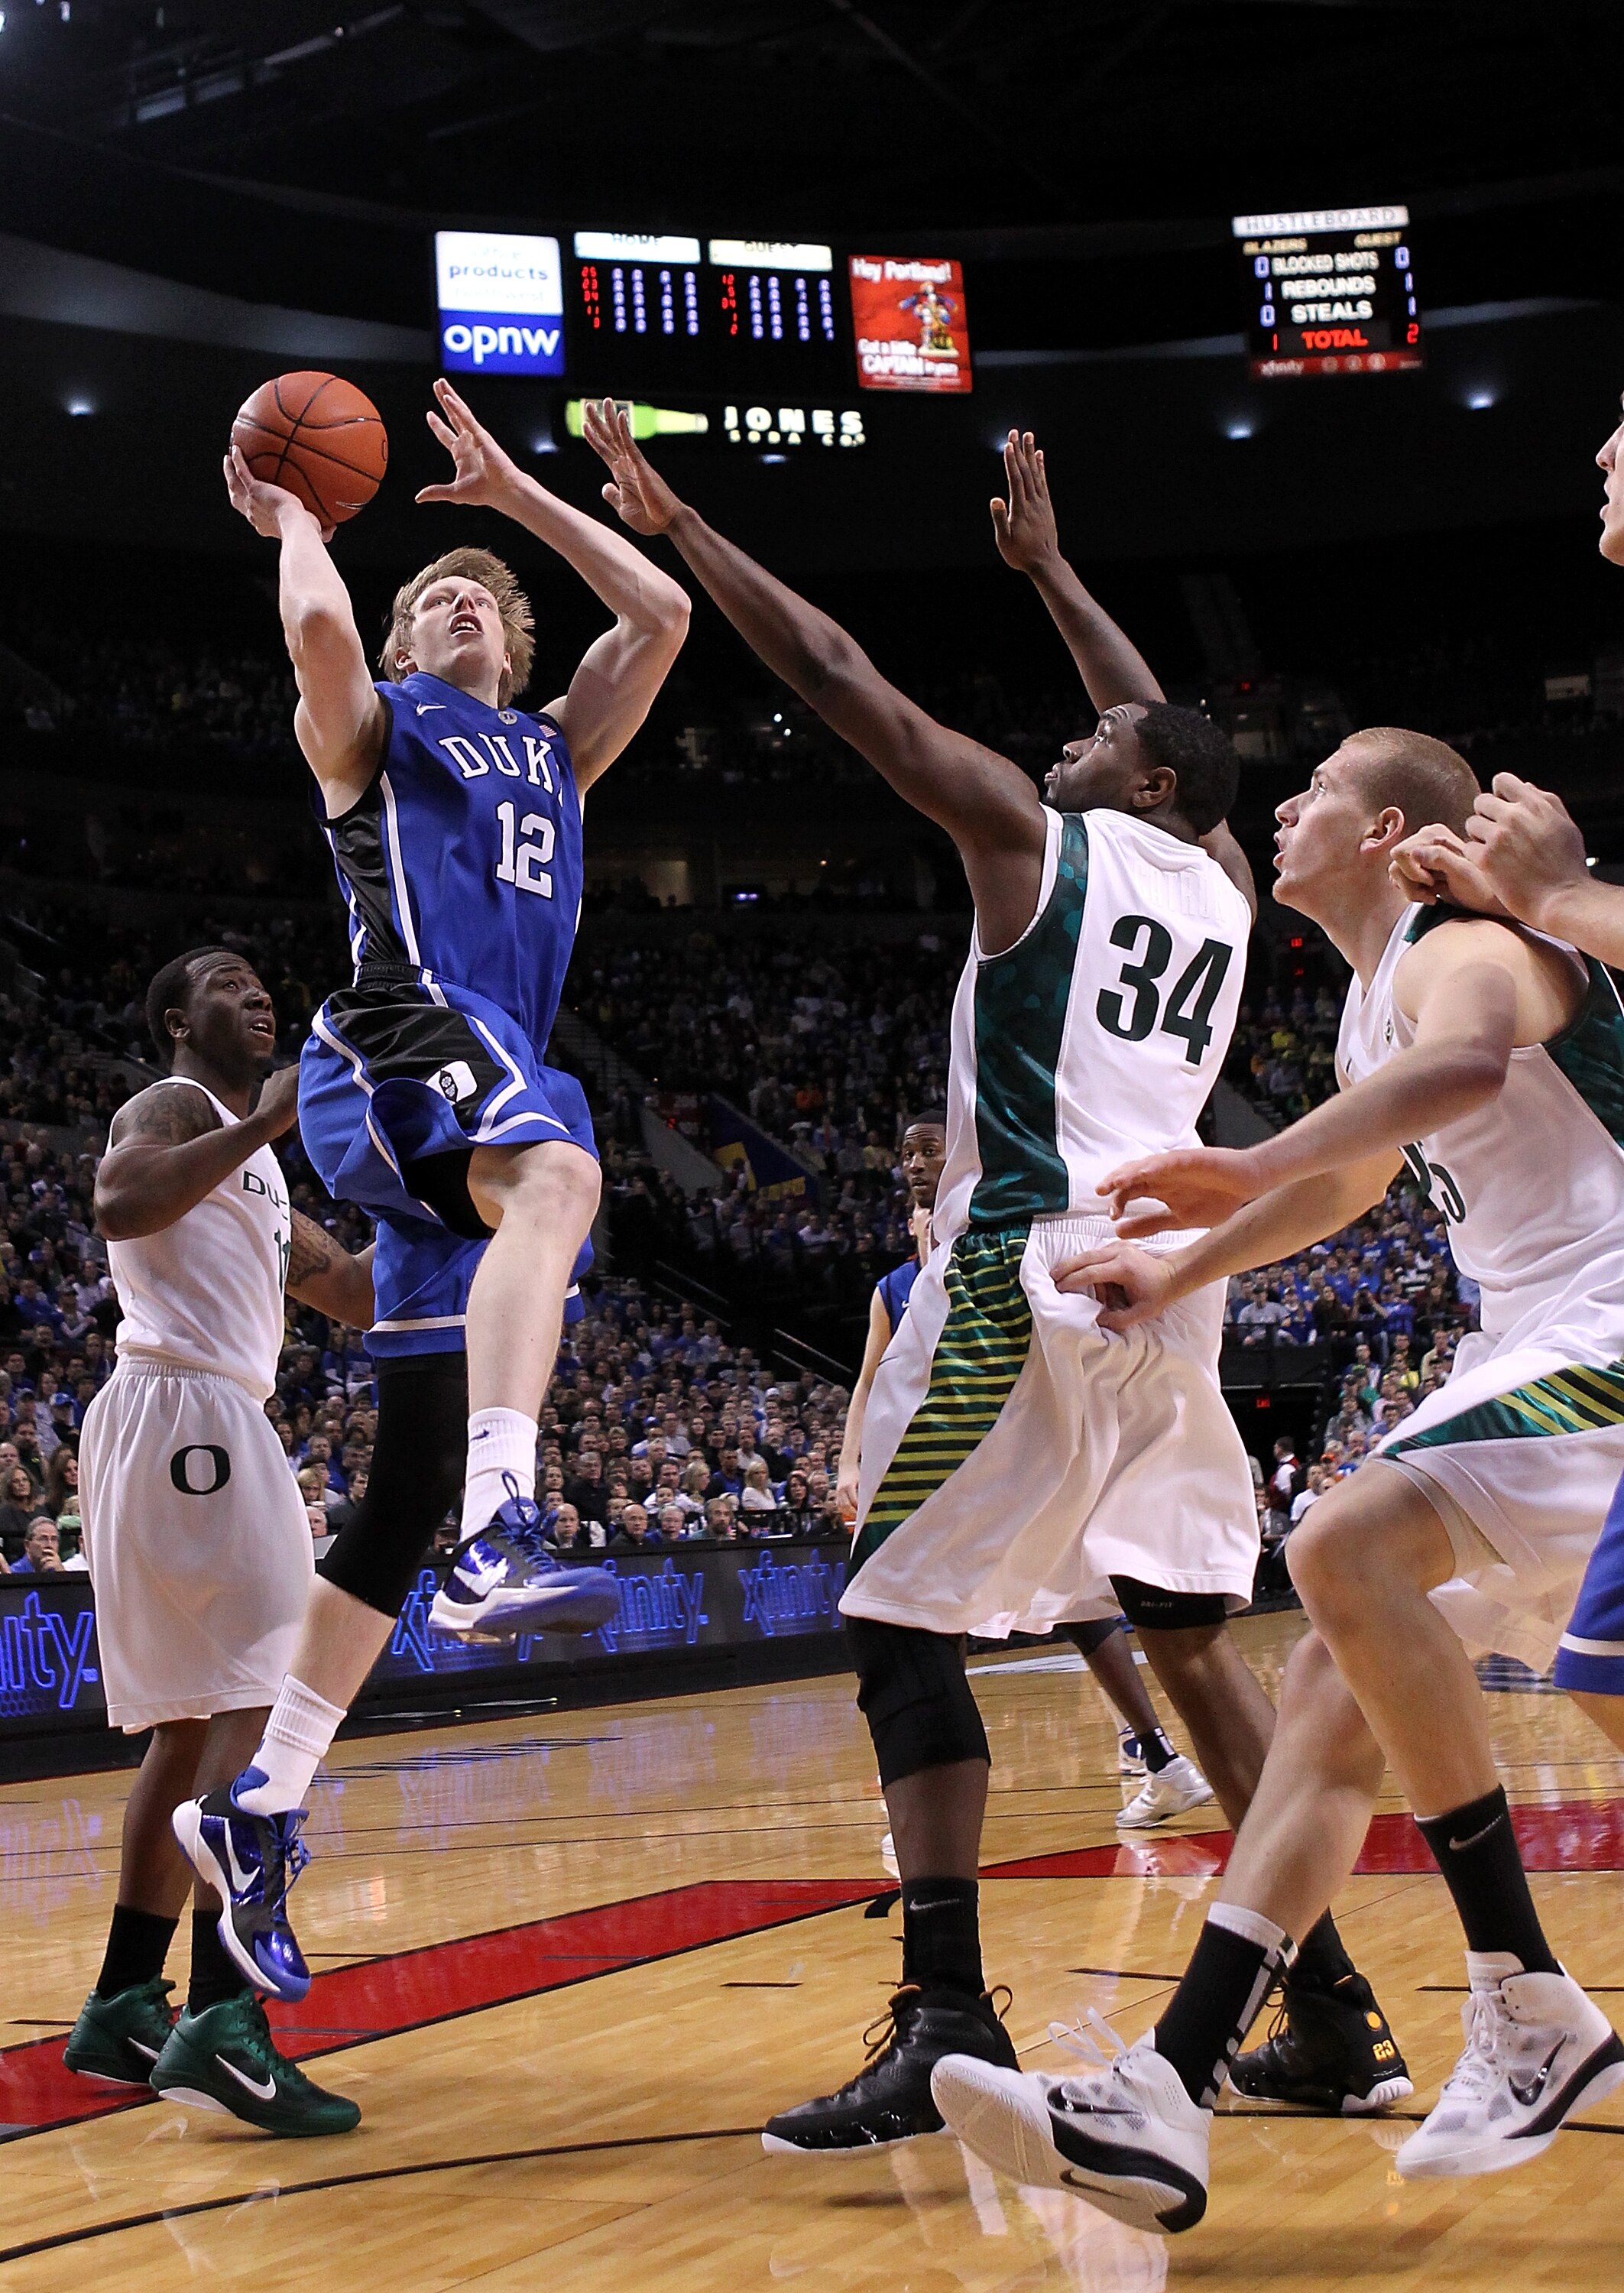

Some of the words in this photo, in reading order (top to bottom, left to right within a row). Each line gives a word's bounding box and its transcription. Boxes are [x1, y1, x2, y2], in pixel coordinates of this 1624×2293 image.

[1254, 256, 1269, 278] 0
[1272, 255, 1334, 276] BLOCKED
[1334, 251, 1379, 272] SHOTS
[1395, 246, 1410, 269] 0
[449, 264, 549, 281] products
[1405, 271, 1413, 292] 1
[1265, 281, 1272, 301] 1
[1281, 275, 1376, 300] REBOUNDS
[1260, 304, 1276, 327] 0
[1291, 300, 1373, 323] STEALS
[1408, 296, 1416, 316] 1
[443, 324, 560, 365] opnw
[1272, 333, 1278, 351] 1
[1301, 329, 1369, 350] TOTAL
[1407, 323, 1419, 344] 2
[862, 355, 925, 375] CAPTAIN
[724, 406, 864, 434] JONES
[729, 430, 802, 445] SODA
[439, 731, 565, 809] DUK
[496, 801, 556, 900] 12
[1096, 914, 1233, 1065] 34
[170, 1444, 232, 1496] O
[1373, 2039, 1395, 2063] 23
